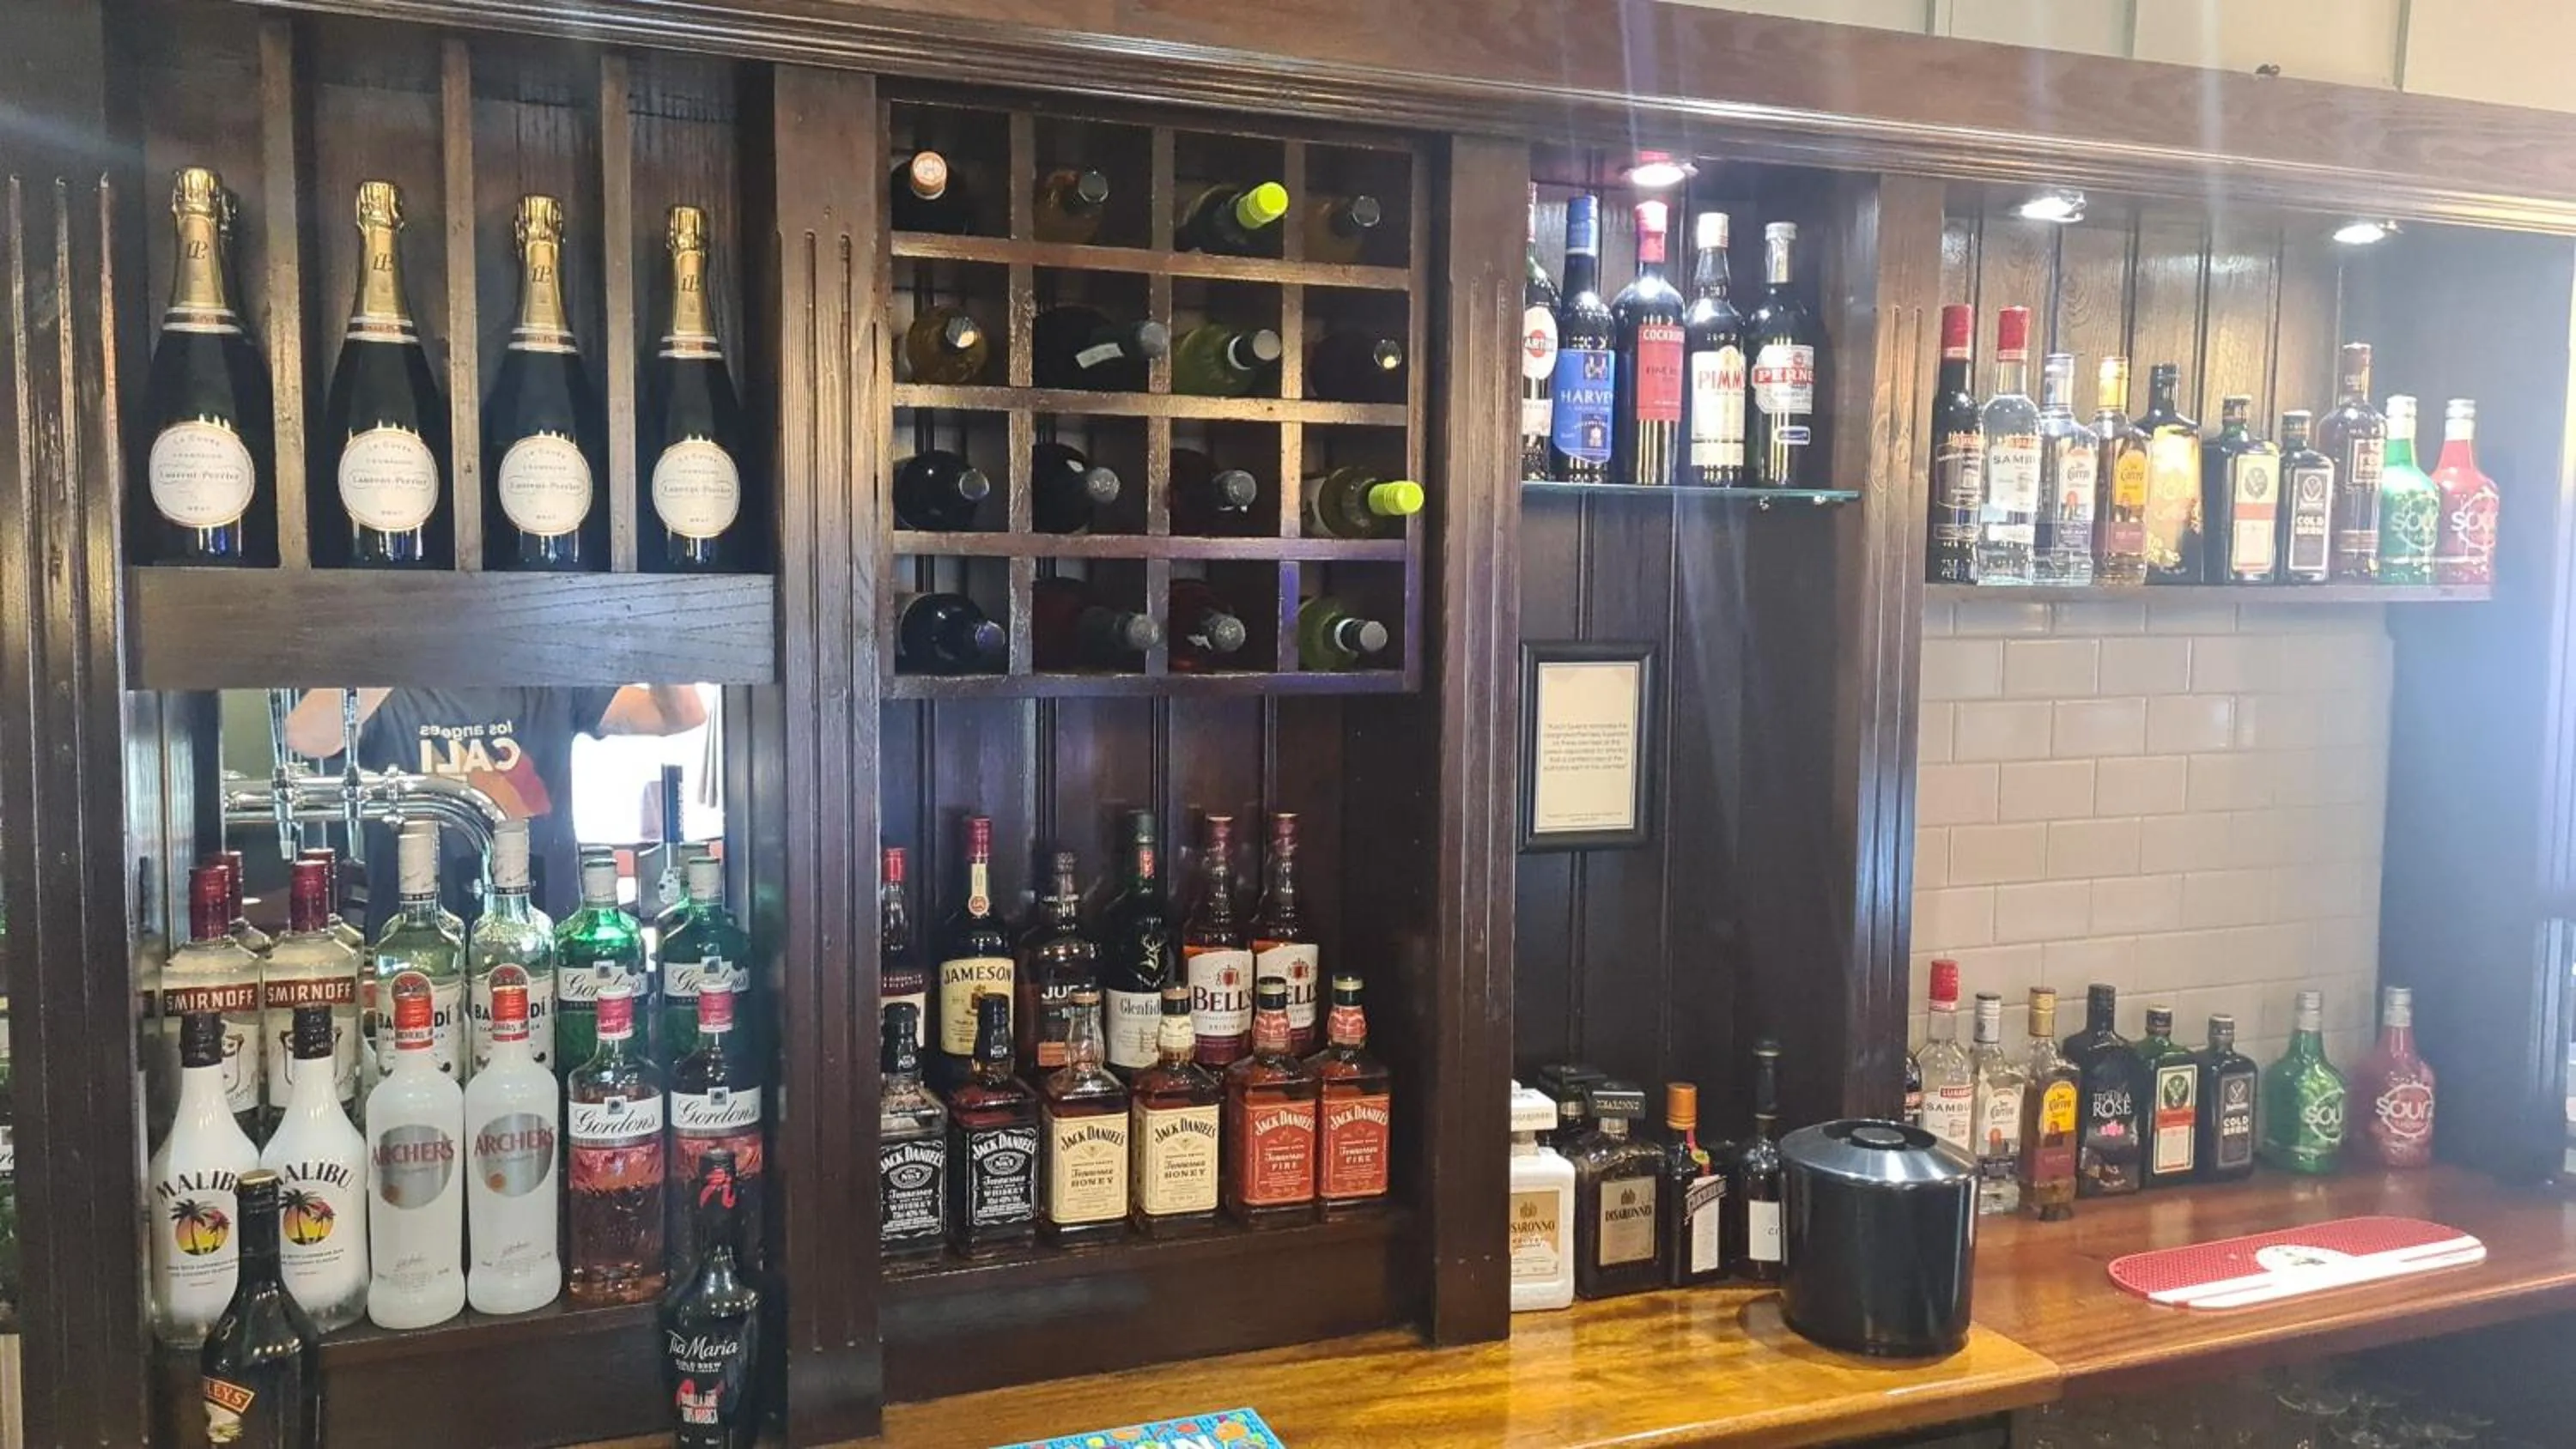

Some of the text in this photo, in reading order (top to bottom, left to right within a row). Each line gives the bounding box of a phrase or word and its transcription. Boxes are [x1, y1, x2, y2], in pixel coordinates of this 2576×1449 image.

[1697, 365, 1745, 391] PIMM'
[945, 966, 1012, 985] JAMESON
[166, 988, 254, 1011] SMIRNOFF
[266, 982, 353, 1003] SMIRNOFF
[1119, 997, 1161, 1016] Glenfid
[1925, 1101, 1971, 1114] SAMBU
[2092, 1100, 2133, 1118] ROSE
[1255, 1115, 1279, 1136] JACK
[1331, 1110, 1353, 1131] JACK
[2223, 1116, 2250, 1127] COLD
[474, 1126, 555, 1157] ARCHERS
[1060, 1131, 1087, 1152] JACK
[1155, 1123, 1180, 1143] JACK
[370, 1139, 454, 1167] ARCHERS
[971, 1139, 998, 1160] JACK
[880, 1153, 905, 1174] JACK
[1164, 1168, 1207, 1179] HONEY
[155, 1169, 240, 1203] MALIB
[1071, 1177, 1115, 1189] HONEY
[1510, 1221, 1555, 1234] SARONNO
[684, 1335, 739, 1361] Maria
